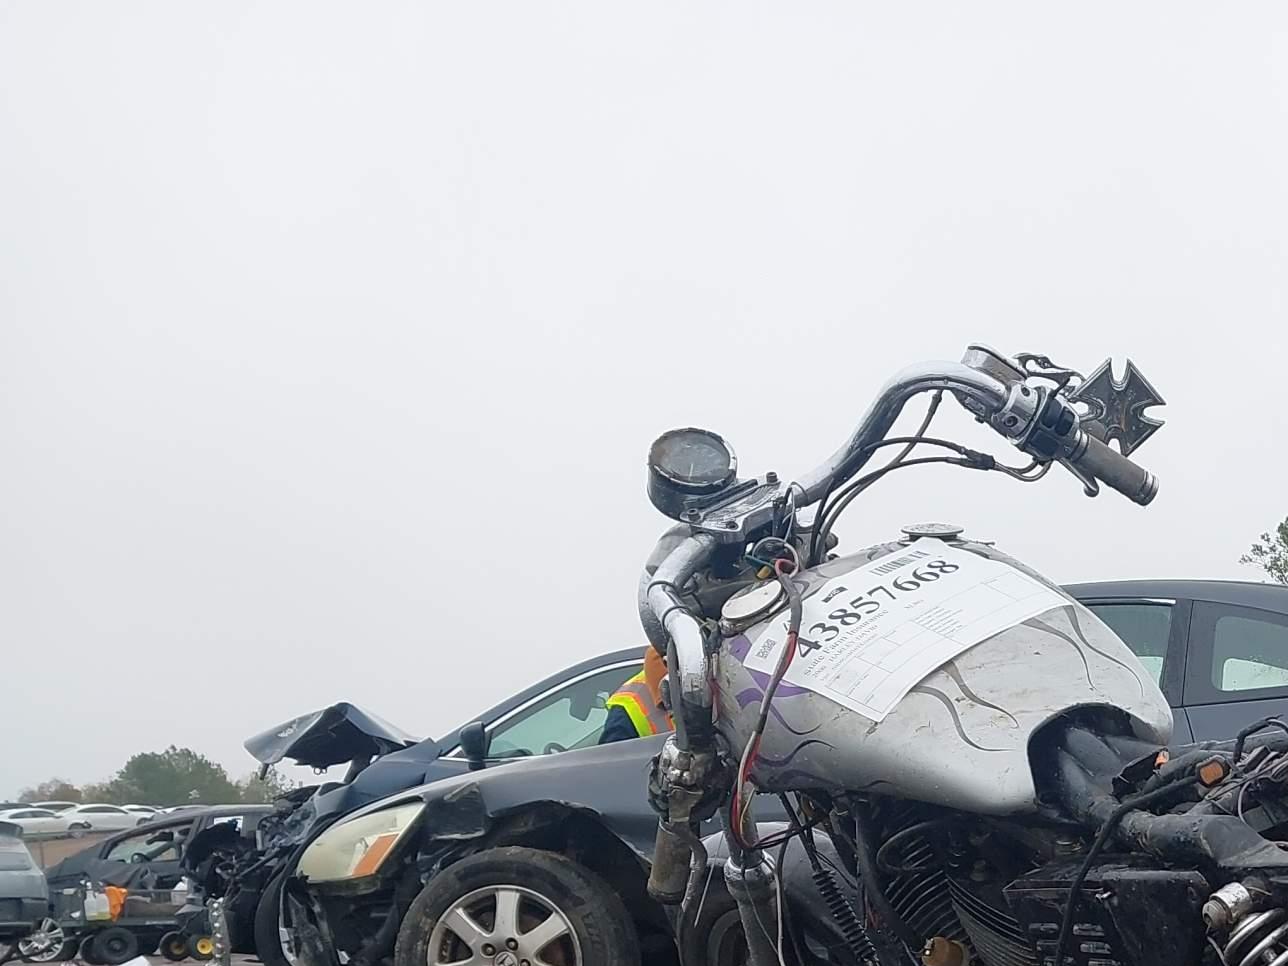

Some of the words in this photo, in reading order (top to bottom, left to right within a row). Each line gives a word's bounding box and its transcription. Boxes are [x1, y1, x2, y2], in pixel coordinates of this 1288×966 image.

[797, 559, 960, 659] 43857668
[822, 635, 848, 655] Farm
[845, 609, 889, 637] Insurance
